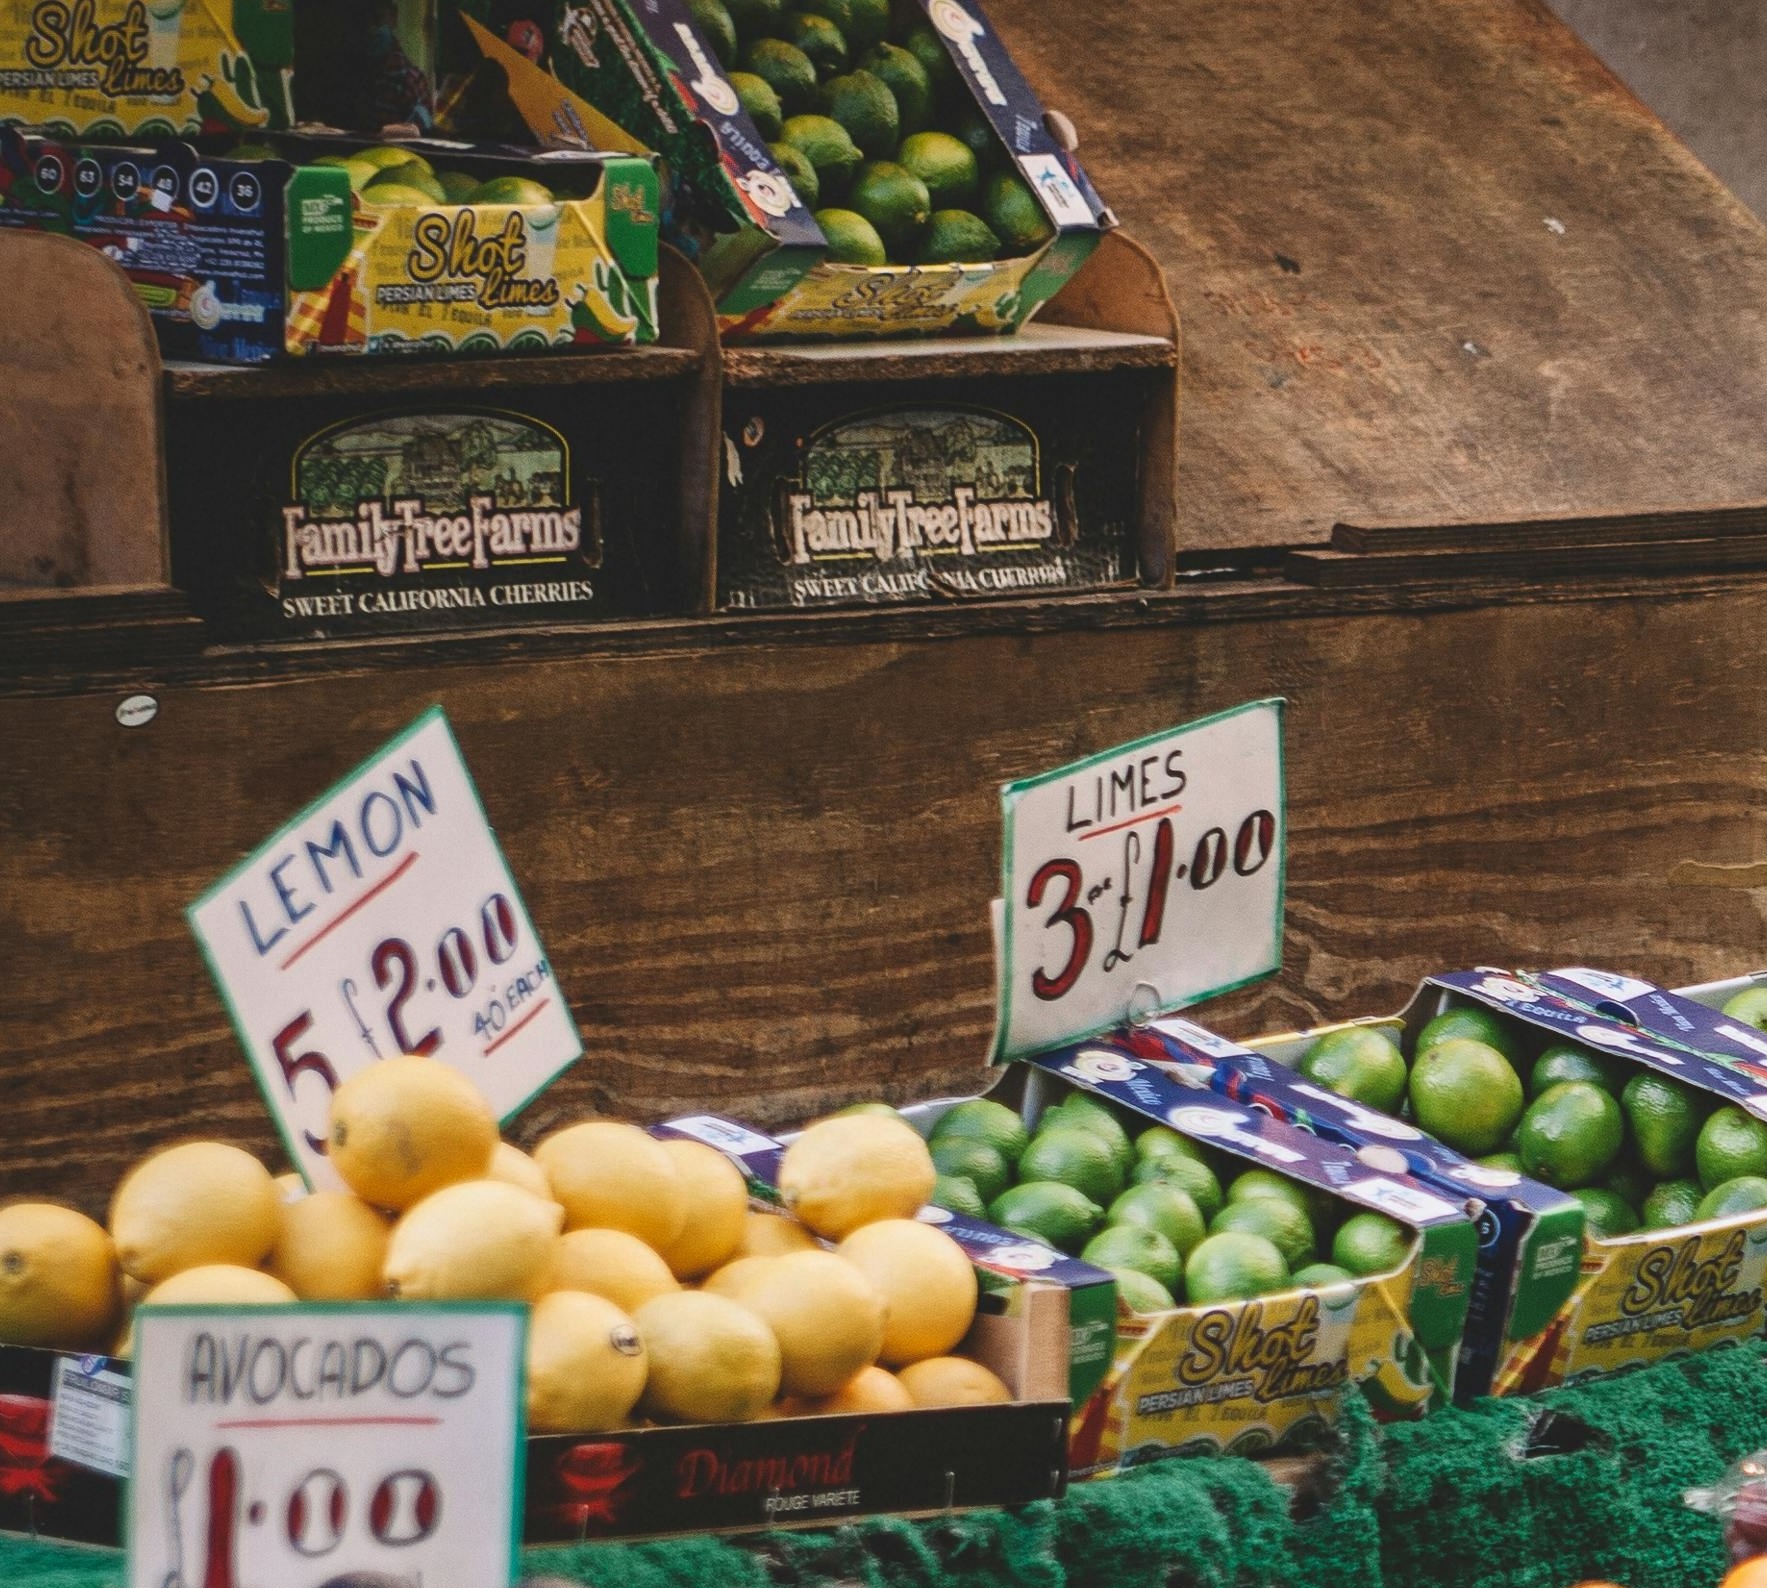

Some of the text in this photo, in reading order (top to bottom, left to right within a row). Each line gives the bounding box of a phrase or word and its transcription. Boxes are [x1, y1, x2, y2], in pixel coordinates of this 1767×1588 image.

[25, 0, 150, 69] Shot
[58, 70, 98, 87] LIMES
[237, 184, 254, 198] 36
[407, 208, 526, 283] Shot
[377, 282, 477, 303] PERSIAN LIMES
[282, 580, 594, 618] SWEET CALIFORNIA CHERRIES
[794, 576, 858, 600] SWEET
[1066, 750, 1188, 833] LIMES
[239, 758, 438, 957] LEMON
[1026, 857, 1094, 1002] 3
[504, 959, 550, 1011] EACH
[271, 1009, 342, 1157] 5
[1621, 1229, 1747, 1317] Shot
[1177, 1294, 1321, 1386] Shot
[1586, 1309, 1683, 1342] PERSIAN LIMES
[184, 1332, 479, 1406] AVOCADOS
[1139, 1379, 1254, 1413] PERSIAN LIMES
[676, 1423, 868, 1498] Diamond
[765, 1493, 809, 1512] ROUGE
